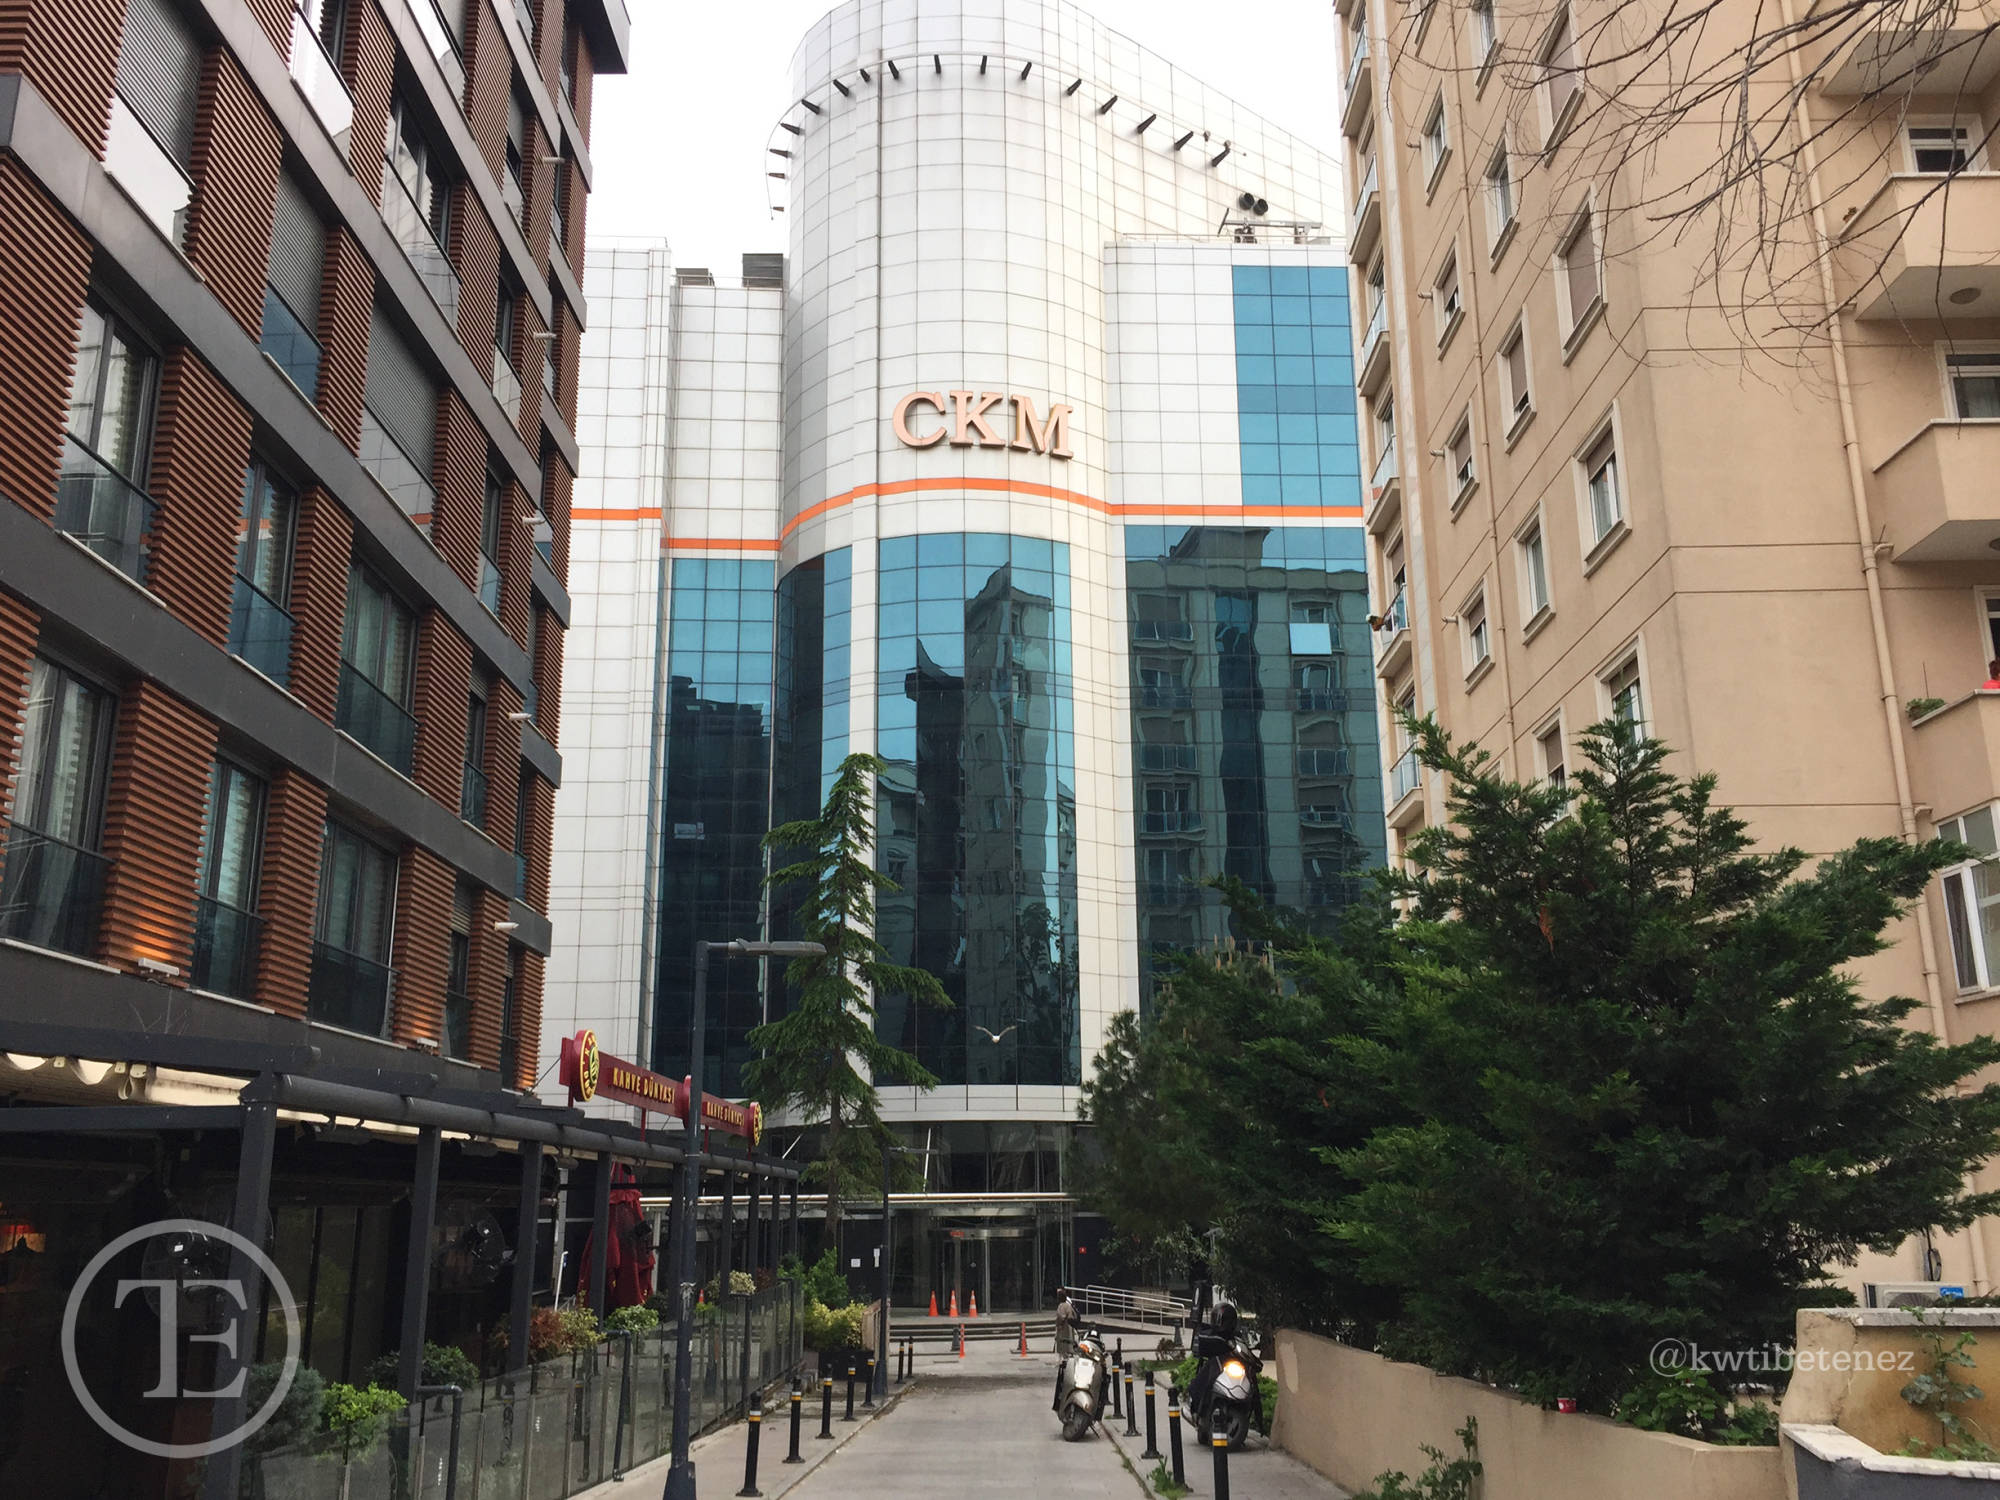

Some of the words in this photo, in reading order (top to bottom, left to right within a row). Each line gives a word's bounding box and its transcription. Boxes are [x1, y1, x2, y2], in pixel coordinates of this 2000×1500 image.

[892, 390, 1074, 460] CKM
[612, 1067, 641, 1094] KAHVE
[643, 1076, 675, 1104] DÜNYASI
